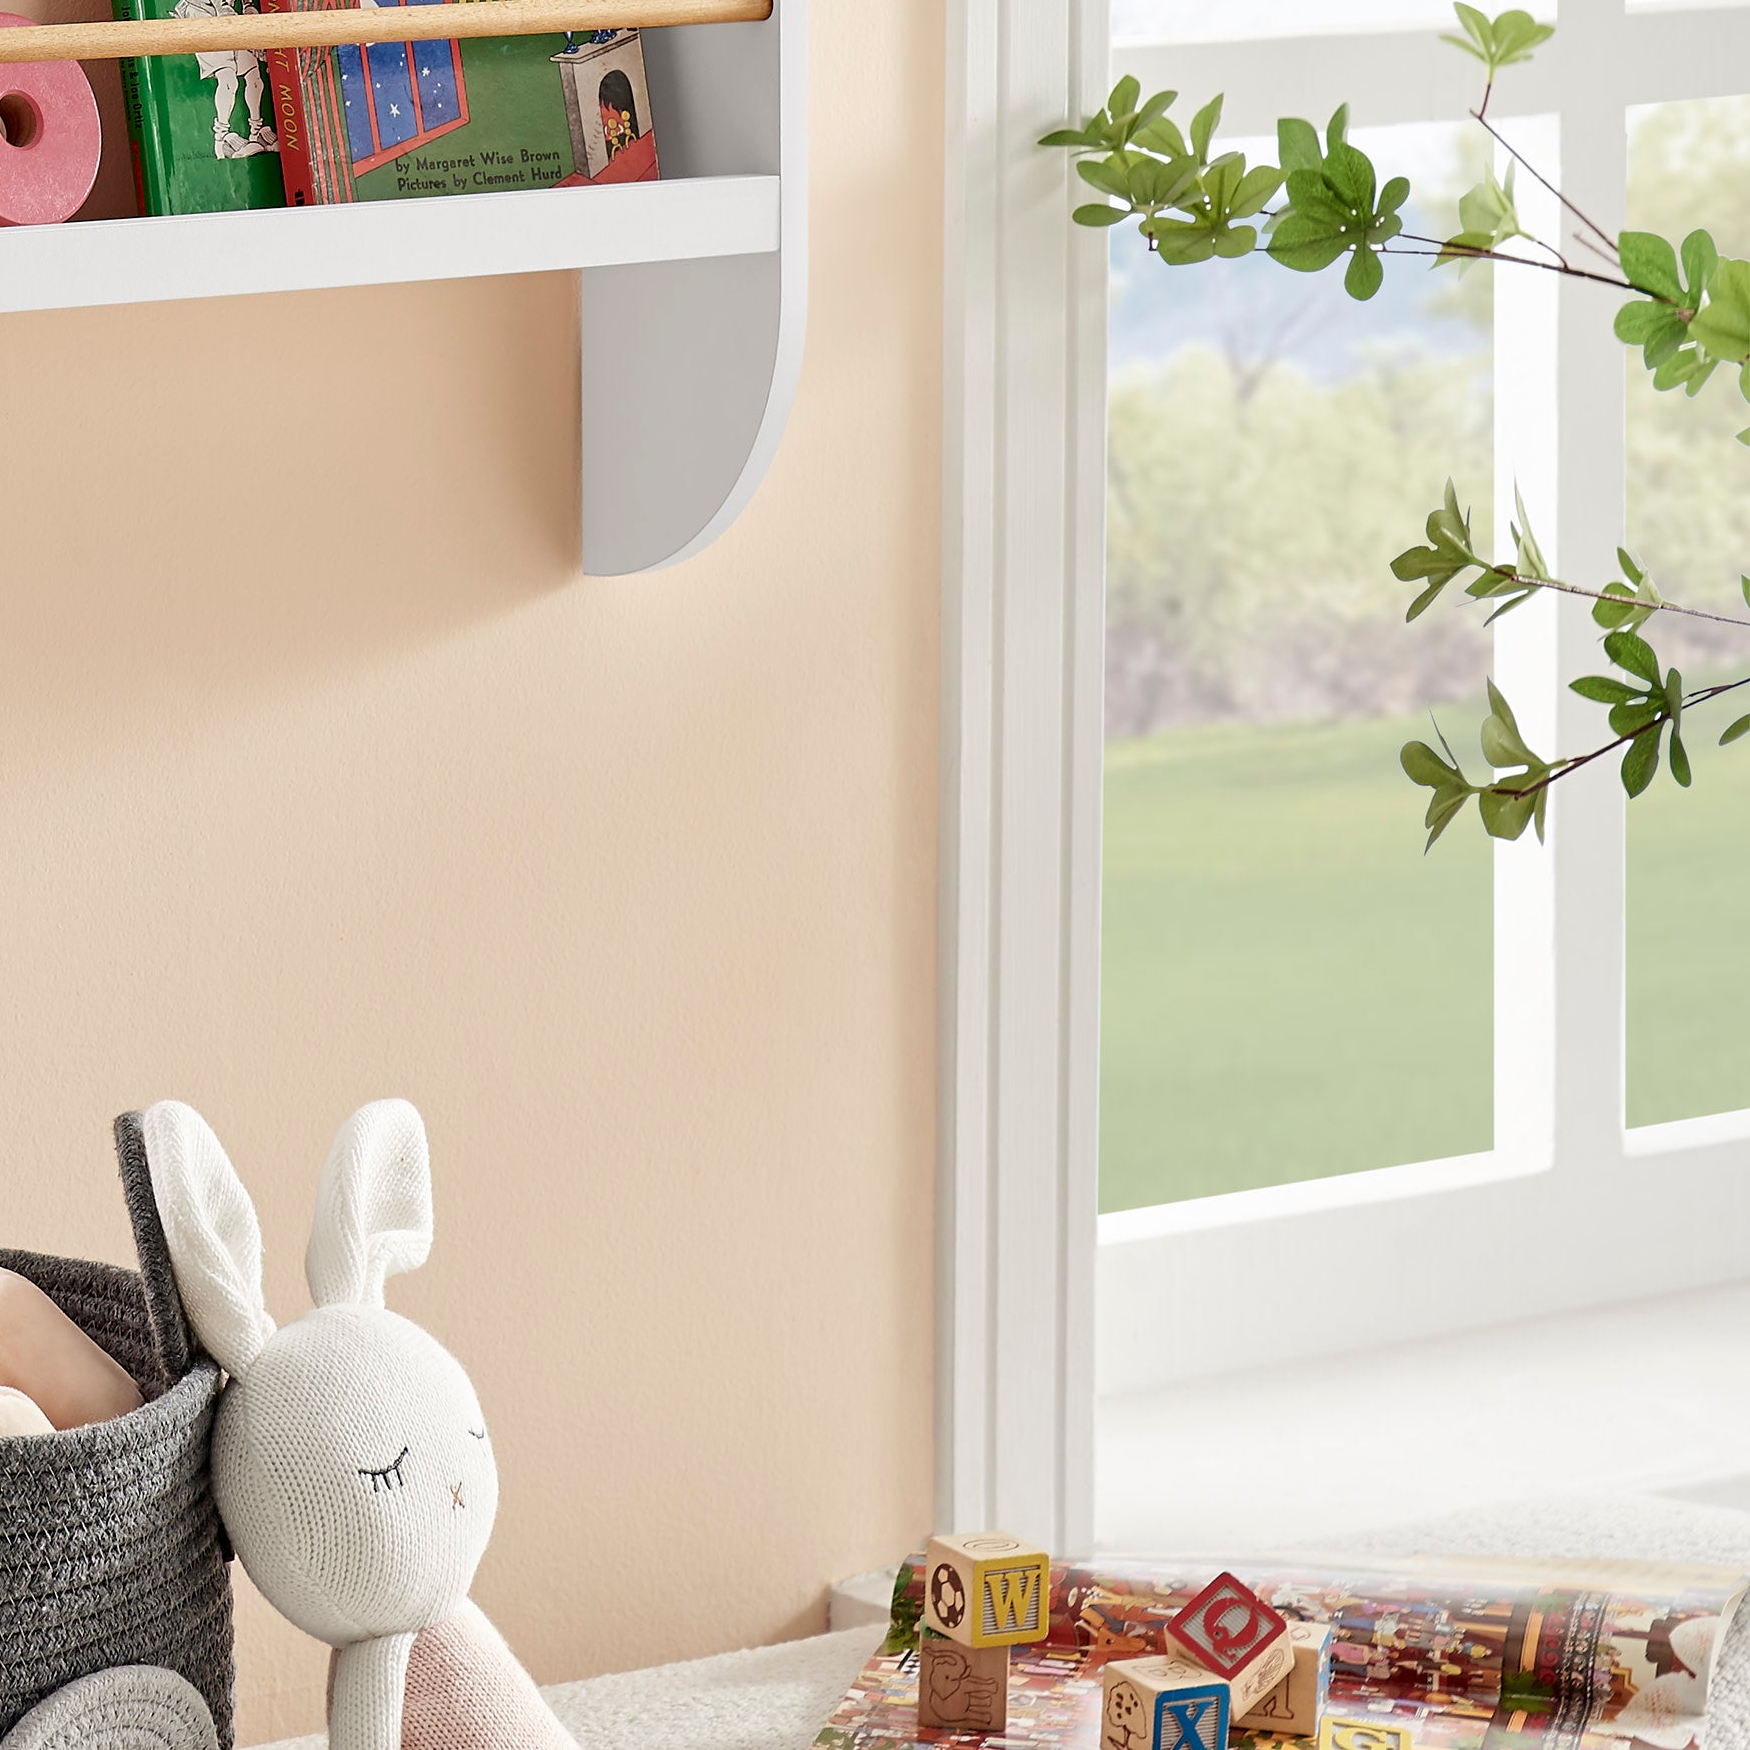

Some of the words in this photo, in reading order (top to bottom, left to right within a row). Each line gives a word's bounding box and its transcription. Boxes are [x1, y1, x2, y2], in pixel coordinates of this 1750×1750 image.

[278, 84, 300, 151] MOON
[395, 157, 410, 174] by
[416, 154, 476, 172] Margaret
[480, 151, 514, 166] Wise
[521, 149, 560, 164] Brown
[397, 177, 447, 191] Pictures
[453, 174, 468, 190] by
[472, 170, 526, 186] Clement
[531, 165, 563, 182] Hurd
[985, 1569, 1041, 1630] W
[1203, 1596, 1259, 1659] Q
[1166, 1701, 1214, 1750] X
